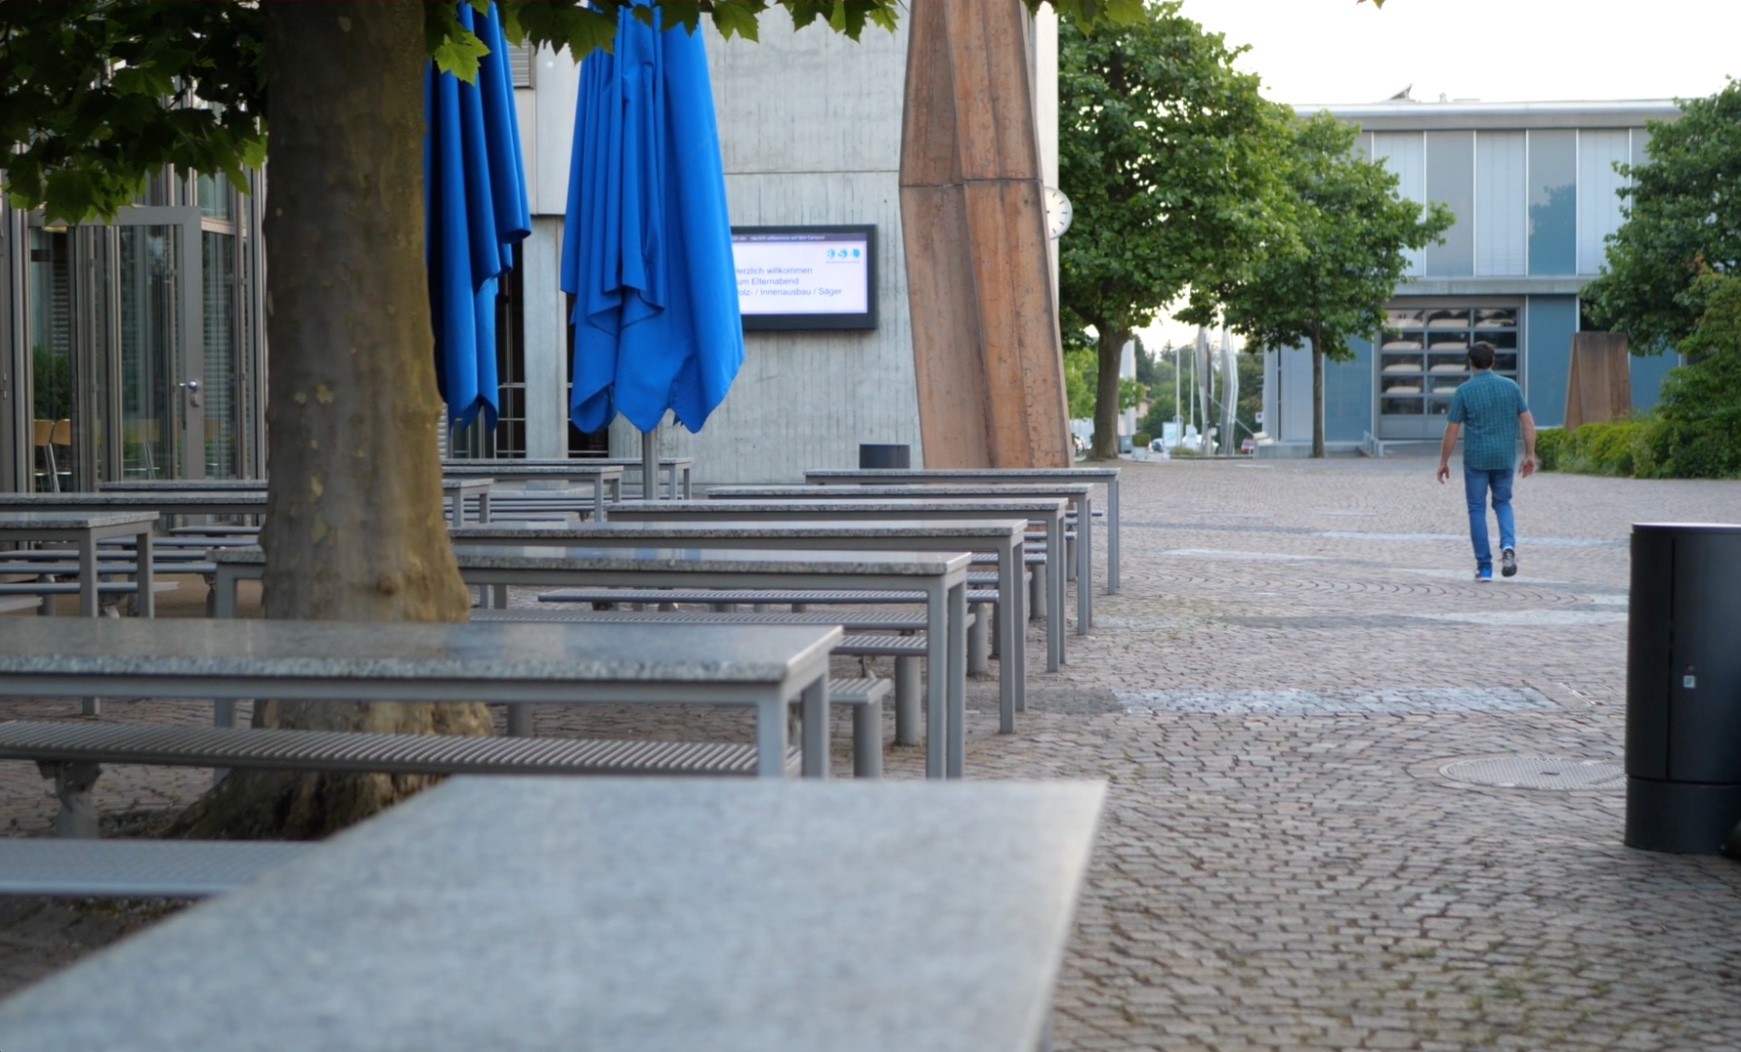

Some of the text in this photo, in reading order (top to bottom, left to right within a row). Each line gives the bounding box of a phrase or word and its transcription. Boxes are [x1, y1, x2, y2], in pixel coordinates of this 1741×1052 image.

[767, 266, 813, 275] willkommen
[751, 277, 799, 286] Elternabend
[738, 288, 753, 297] olz-
[760, 287, 812, 296] Innenausbau
[818, 286, 842, 298] Säger
